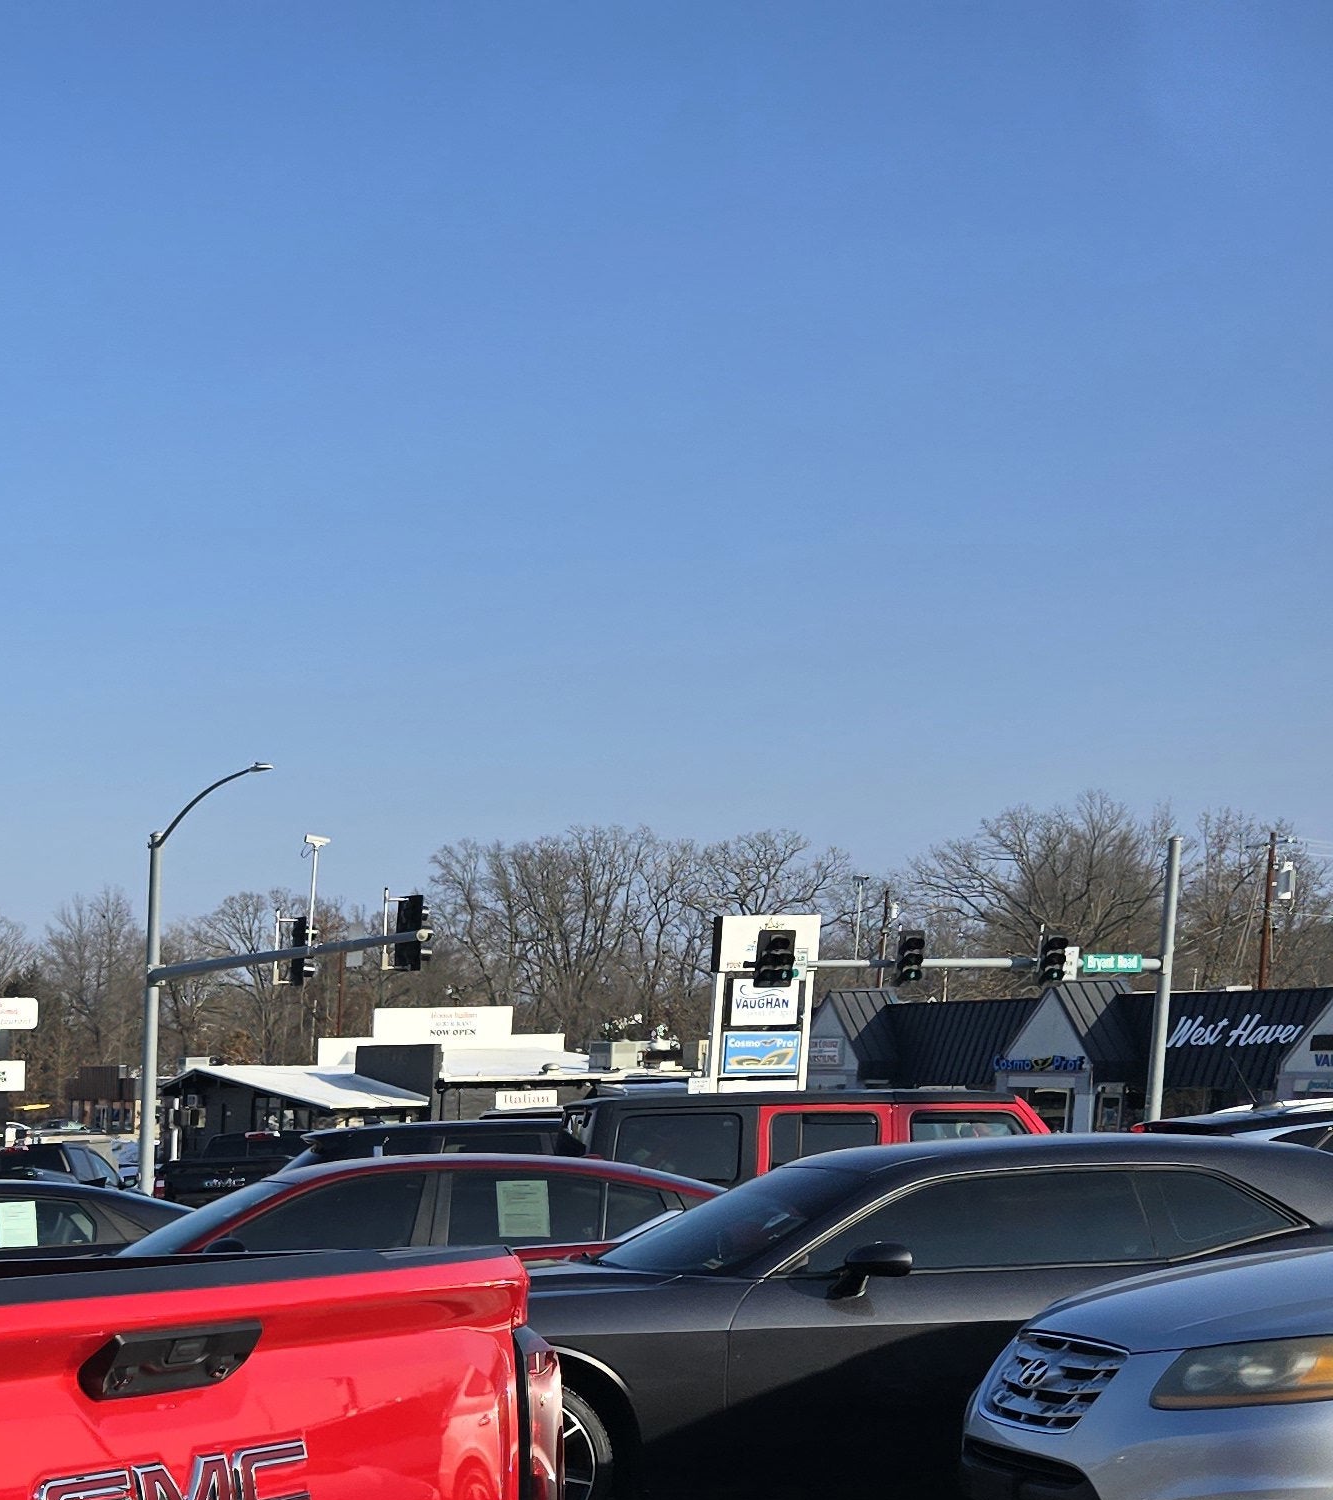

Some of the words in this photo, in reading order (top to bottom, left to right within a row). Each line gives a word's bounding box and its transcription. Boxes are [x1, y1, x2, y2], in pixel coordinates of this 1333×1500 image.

[1087, 955, 1115, 971] Bryant
[1117, 955, 1138, 969] Road
[735, 998, 789, 1010] VAUGHAN
[1166, 1015, 1229, 1048] West
[728, 1036, 761, 1048] Cosmo
[776, 1036, 797, 1048] Prof
[994, 1056, 1032, 1071] Cosmo
[1052, 1055, 1087, 1071] Prof
[504, 1094, 549, 1104] Italian
